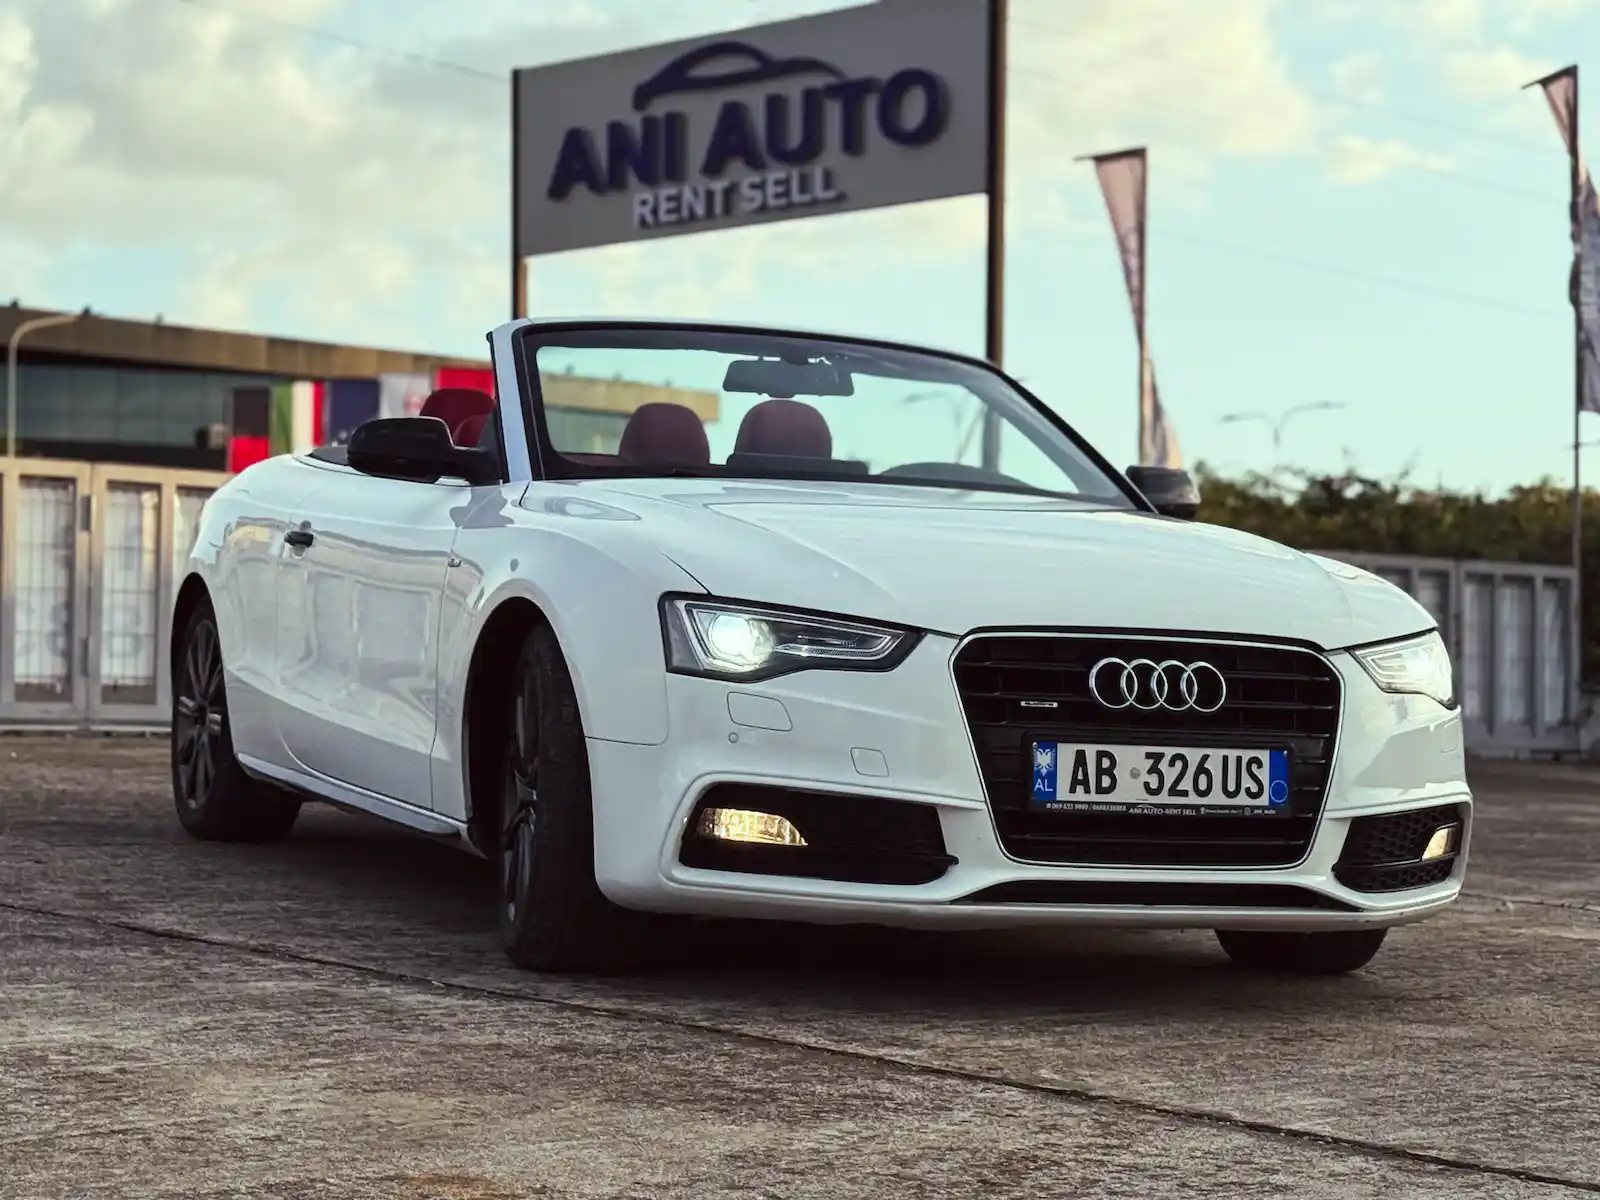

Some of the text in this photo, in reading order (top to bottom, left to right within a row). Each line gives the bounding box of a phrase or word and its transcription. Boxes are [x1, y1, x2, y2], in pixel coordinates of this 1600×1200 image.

[547, 69, 949, 201] ANI AUTO
[634, 167, 840, 229] RENT SELL
[1034, 777, 1054, 793] AL
[1068, 749, 1118, 795] AB
[1182, 808, 1196, 816] SELL
